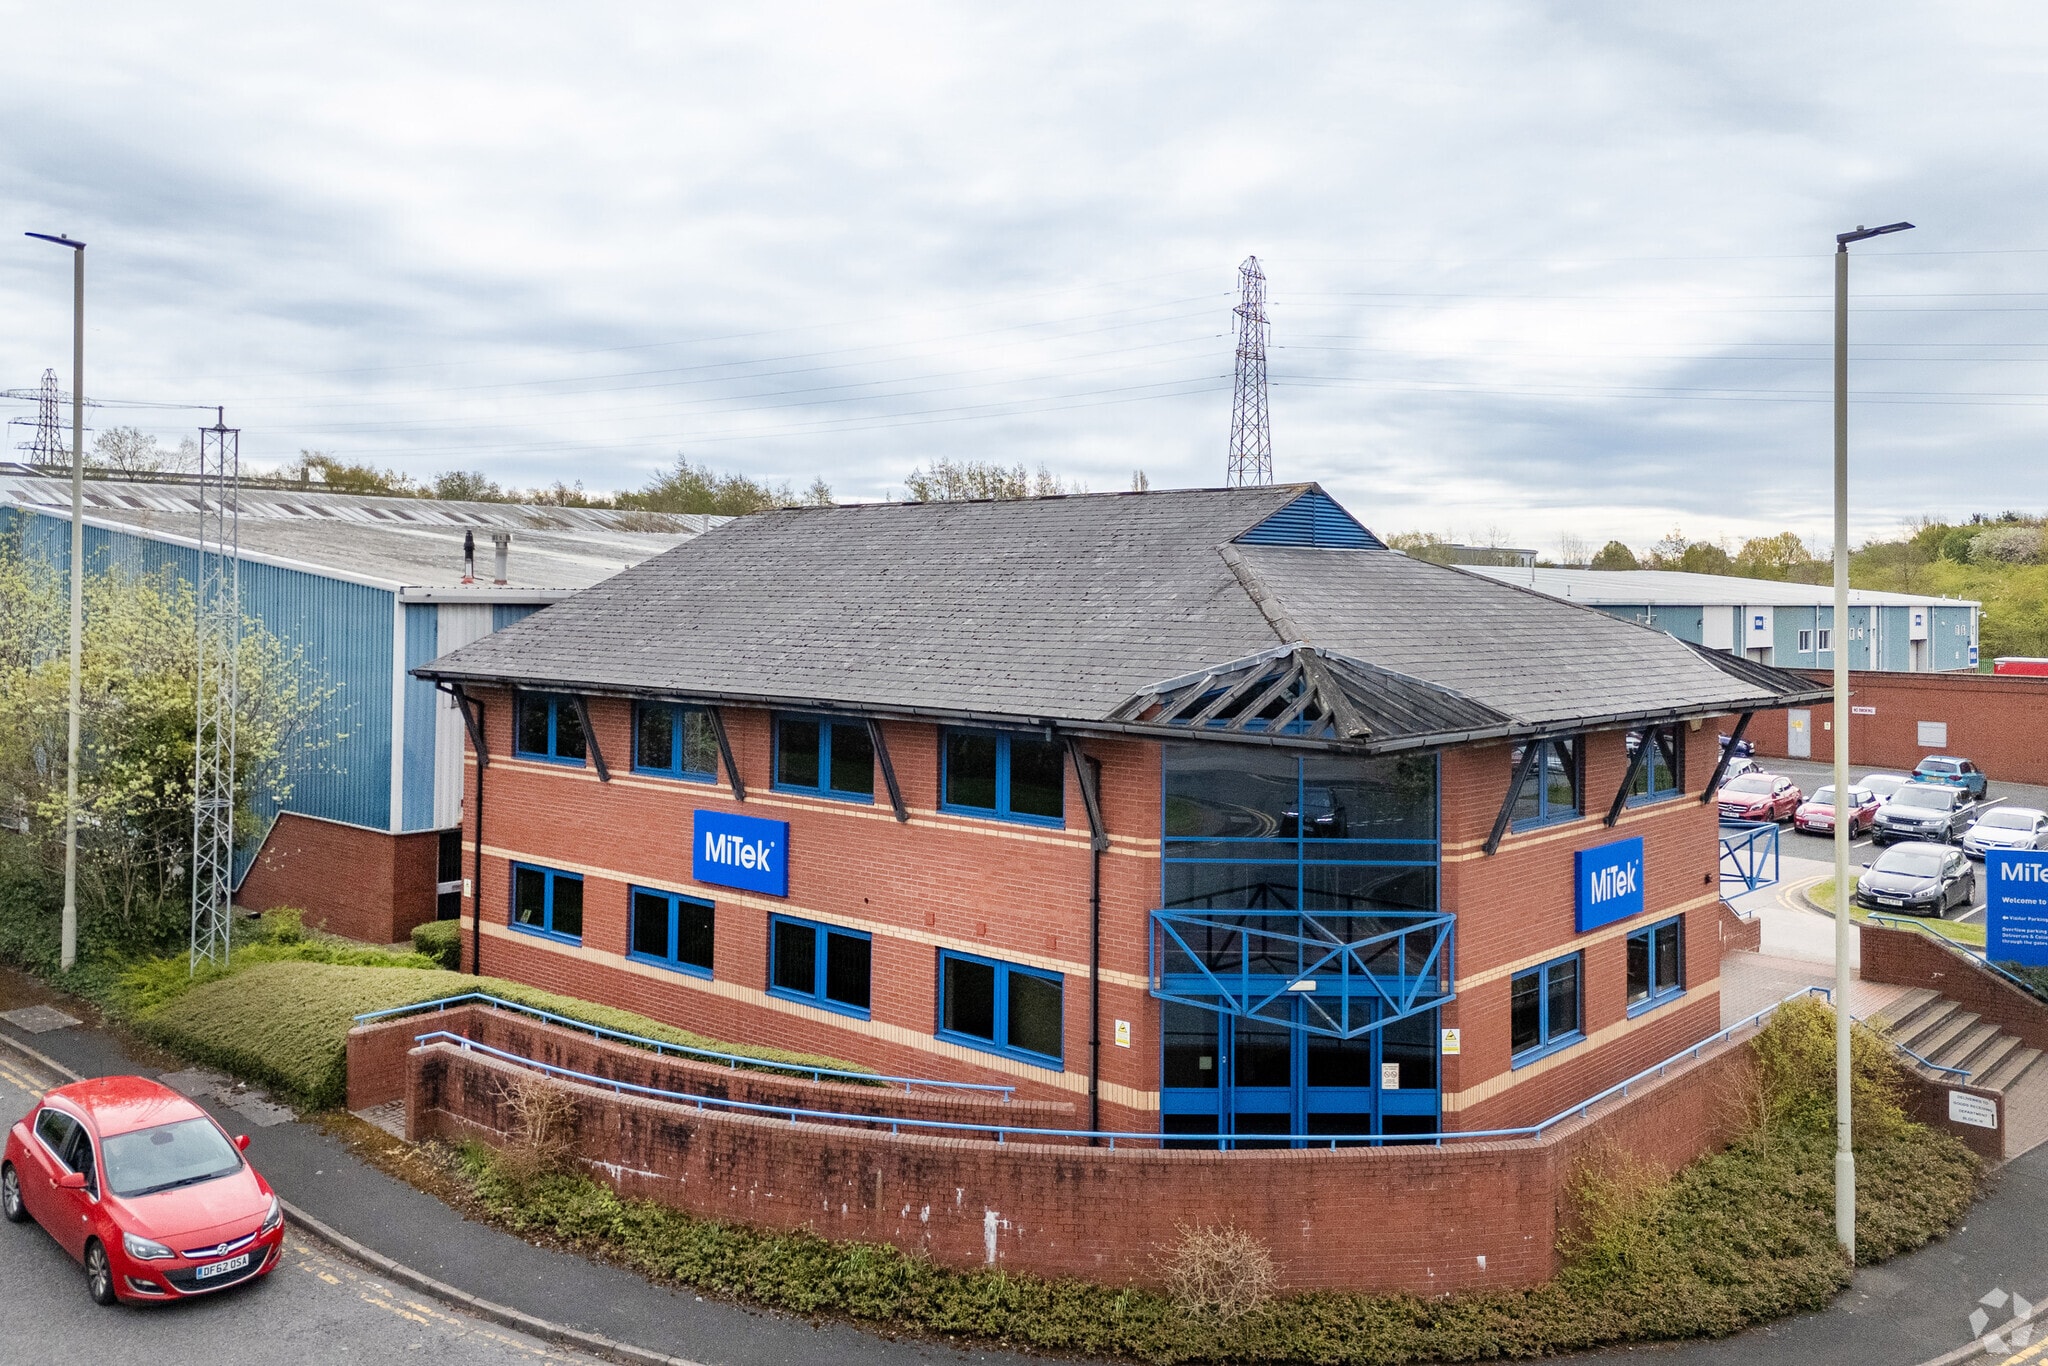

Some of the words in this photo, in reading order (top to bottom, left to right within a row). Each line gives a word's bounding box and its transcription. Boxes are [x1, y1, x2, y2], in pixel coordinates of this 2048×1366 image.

[705, 831, 771, 872] MiTek
[1591, 861, 1636, 905] MiTek
[1958, 1109, 1988, 1117] DEPARTMENT
[203, 1262, 228, 1276] DF62
